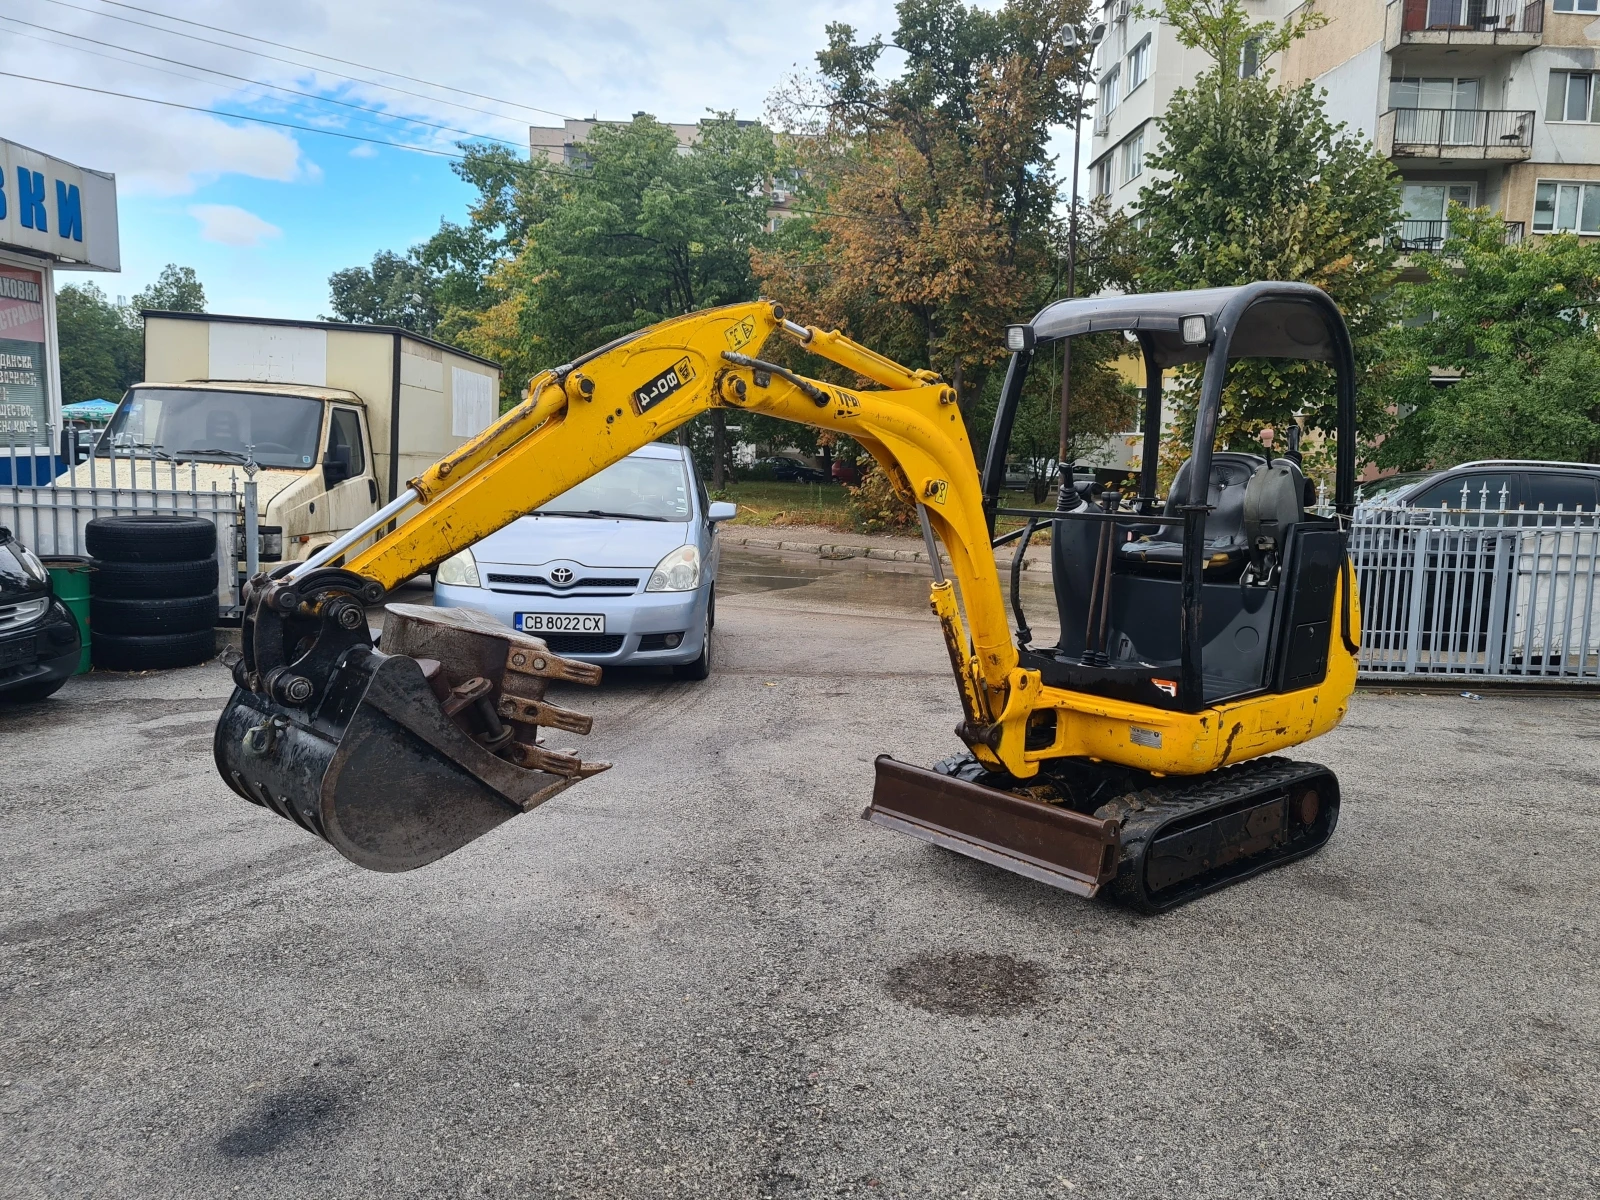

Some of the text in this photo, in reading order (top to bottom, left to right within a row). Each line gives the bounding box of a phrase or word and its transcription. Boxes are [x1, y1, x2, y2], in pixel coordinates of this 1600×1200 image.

[639, 372, 678, 406] 8014
[525, 616, 601, 631] CB 8022 CX
